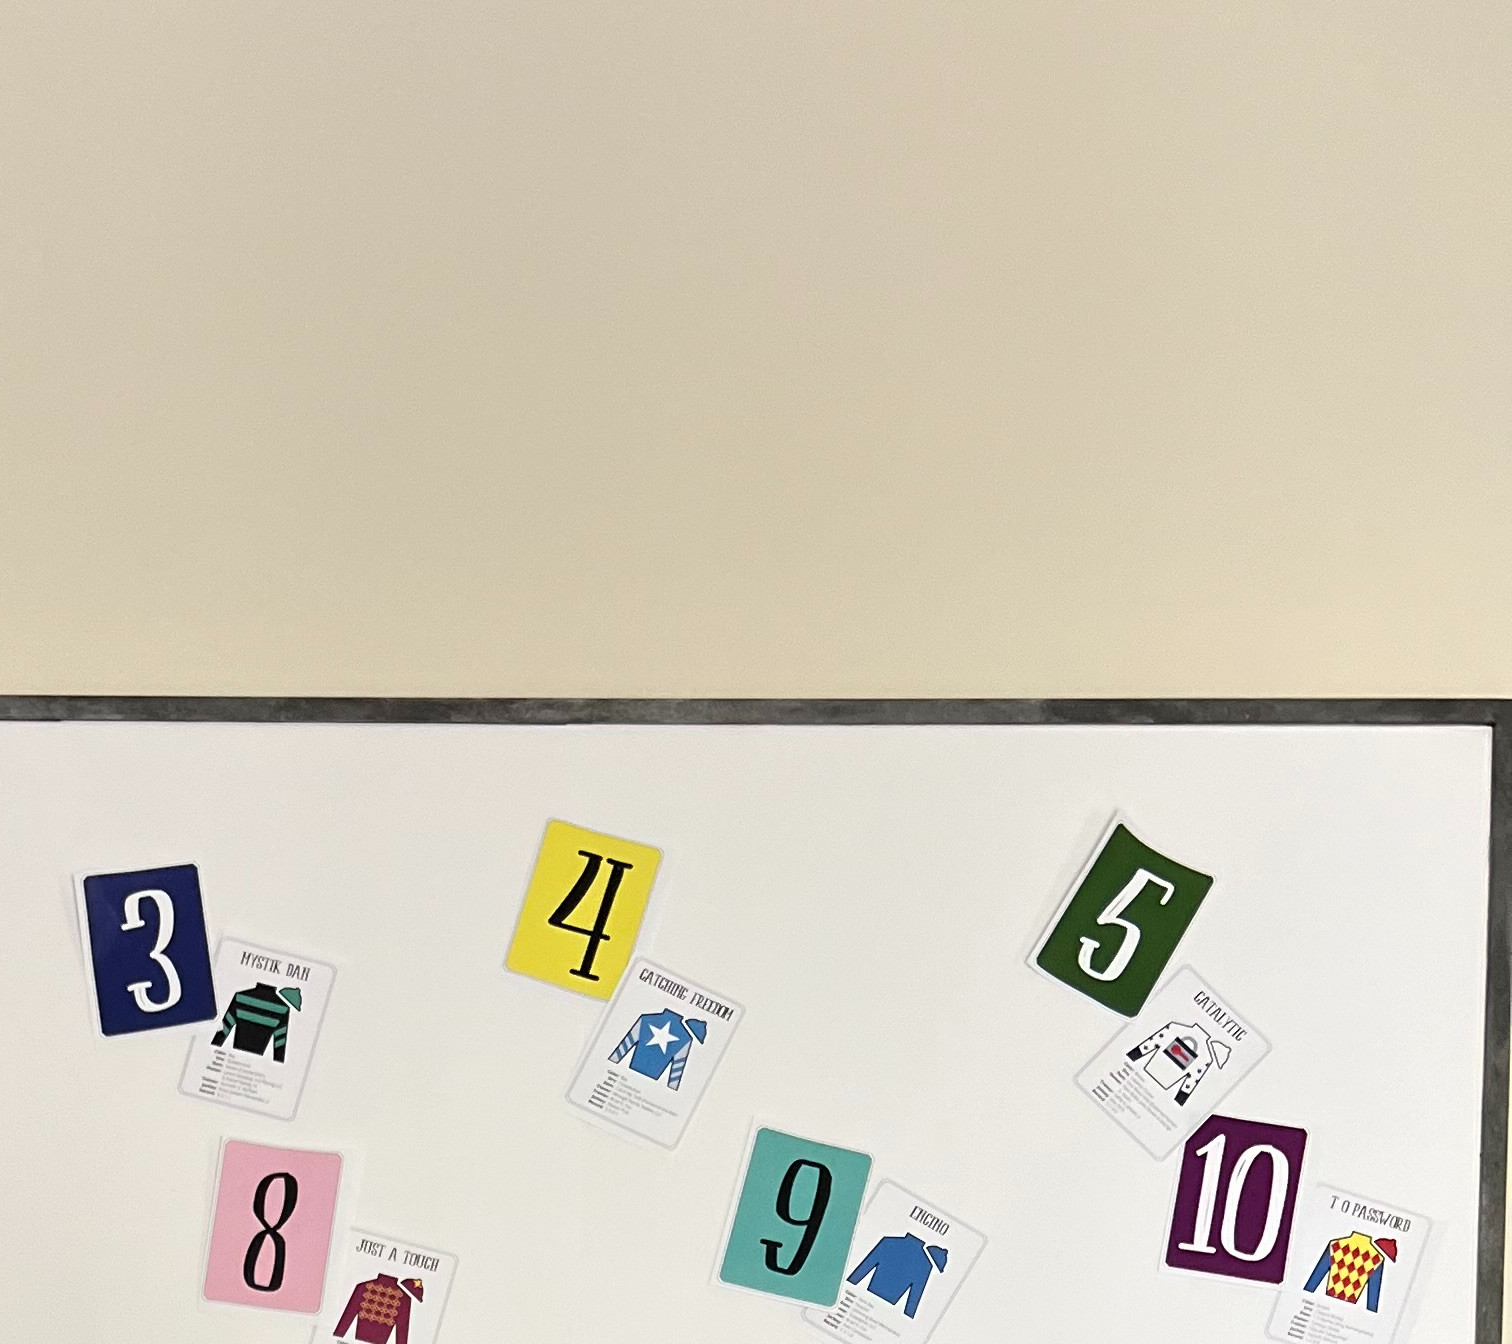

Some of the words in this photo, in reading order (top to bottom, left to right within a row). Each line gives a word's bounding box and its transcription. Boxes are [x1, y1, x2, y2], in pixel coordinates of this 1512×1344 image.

[120, 889, 182, 1013] 3
[240, 951, 283, 974] MYSTIK
[285, 963, 311, 981] DAN
[548, 850, 634, 981] 4
[1077, 868, 1175, 981] 5
[639, 967, 689, 1001] CATCHING
[690, 992, 735, 1022] FREEDOM
[1193, 990, 1248, 1041] CATALYTIC
[243, 1172, 299, 1293] 8
[760, 1159, 832, 1276] 9
[1178, 1133, 1289, 1263] 10
[1352, 1202, 1411, 1232] PASSWORD
[356, 1239, 386, 1258] JUST
[388, 1248, 397, 1262] A
[403, 1251, 440, 1272] TOUCH
